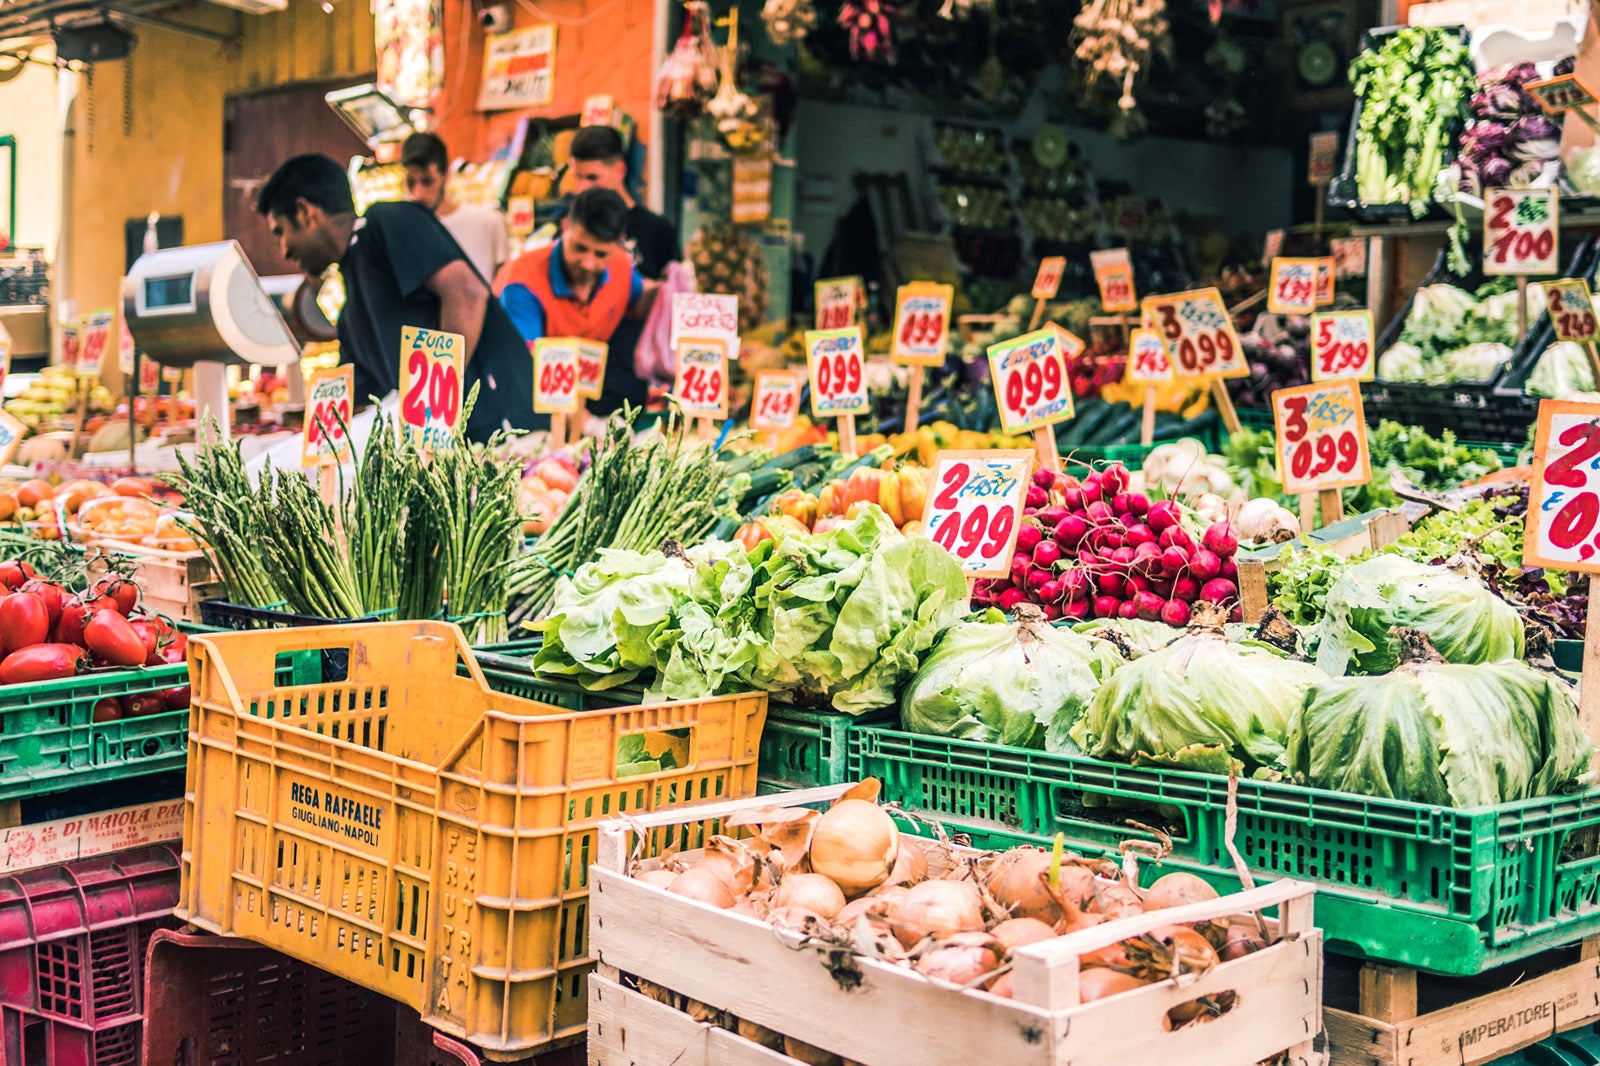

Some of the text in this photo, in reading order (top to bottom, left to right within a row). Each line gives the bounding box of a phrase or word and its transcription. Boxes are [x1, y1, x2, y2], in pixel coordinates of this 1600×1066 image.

[1489, 196, 1514, 229] 2
[1548, 288, 1562, 311] 2
[412, 330, 454, 350] EURO
[1157, 305, 1181, 339] 3
[1317, 319, 1335, 348] 5
[1180, 328, 1234, 373] 0,99
[1318, 341, 1369, 374] 1,99
[681, 365, 721, 404] 1,49
[818, 353, 861, 401] 0,99
[1006, 355, 1061, 418] 0,99
[1284, 396, 1308, 443] 3
[1291, 430, 1358, 480] 0,99
[1544, 423, 1600, 488] 2
[934, 463, 970, 510] 2
[63, 820, 83, 837] DI
[86, 808, 150, 833] MAIOLA
[291, 782, 382, 830] REGA RAFFAELE
[291, 806, 379, 847] GIUGLIANO-NAPOLI
[1459, 1001, 1550, 1046] IMPERATORE
